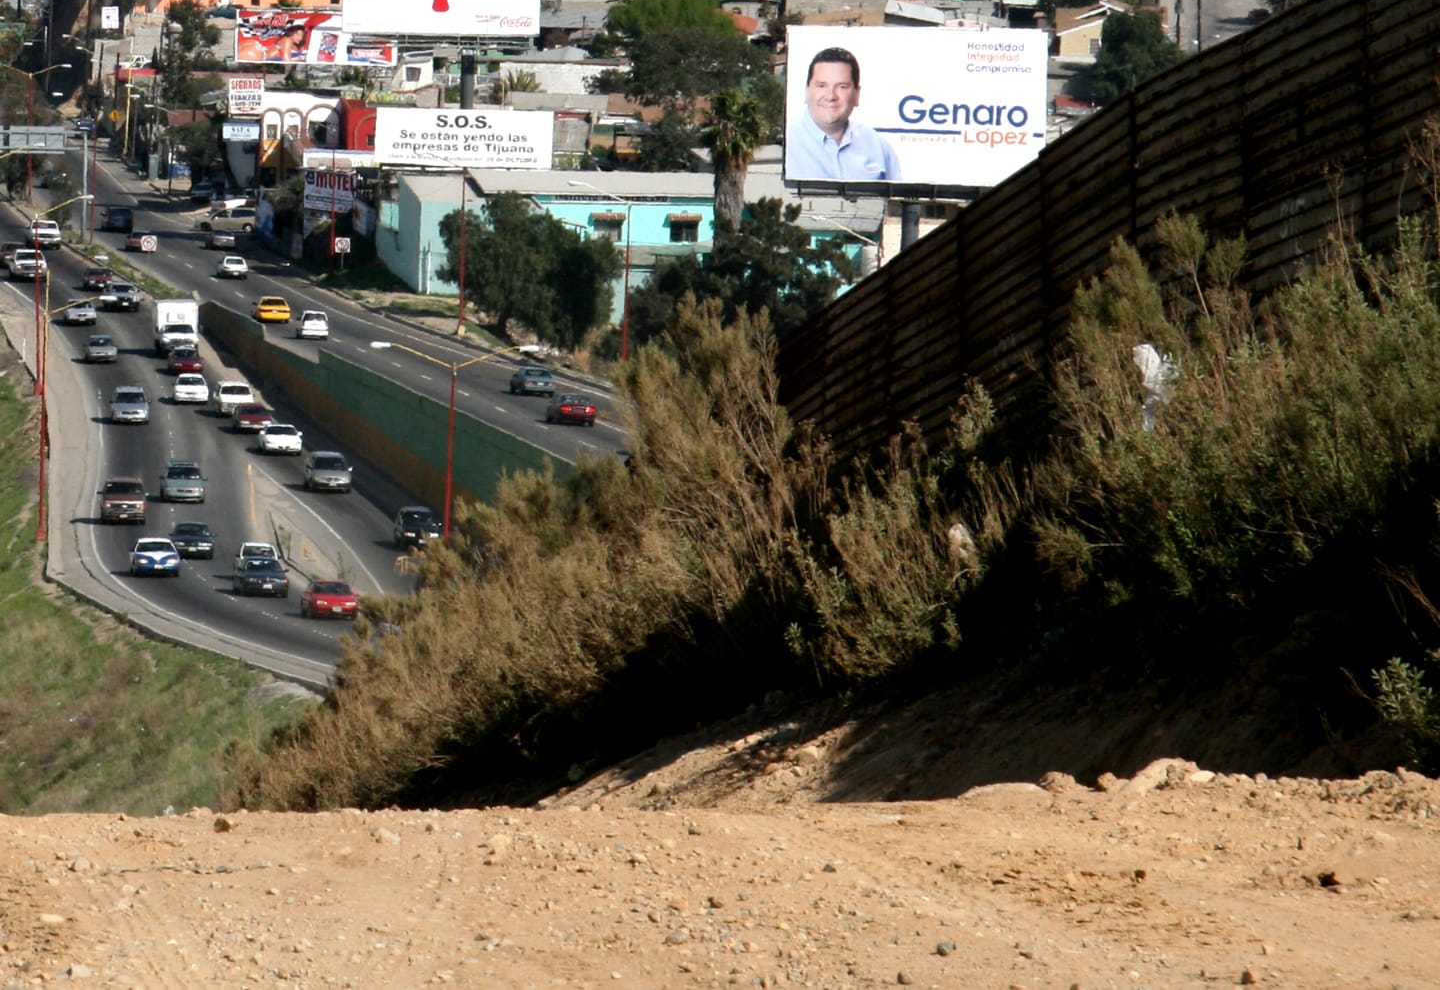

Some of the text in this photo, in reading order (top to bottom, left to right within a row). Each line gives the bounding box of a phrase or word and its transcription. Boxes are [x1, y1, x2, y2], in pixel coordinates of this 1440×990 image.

[967, 42, 1024, 52] Honestidad
[967, 52, 1020, 63] Integridad
[966, 63, 1032, 73] Compromiso
[898, 94, 1028, 127] Genaro
[436, 114, 492, 129] S.O.S.
[400, 129, 528, 144] Se están yendo las
[963, 128, 1028, 148] López
[392, 141, 534, 155] empresas de Tijuana
